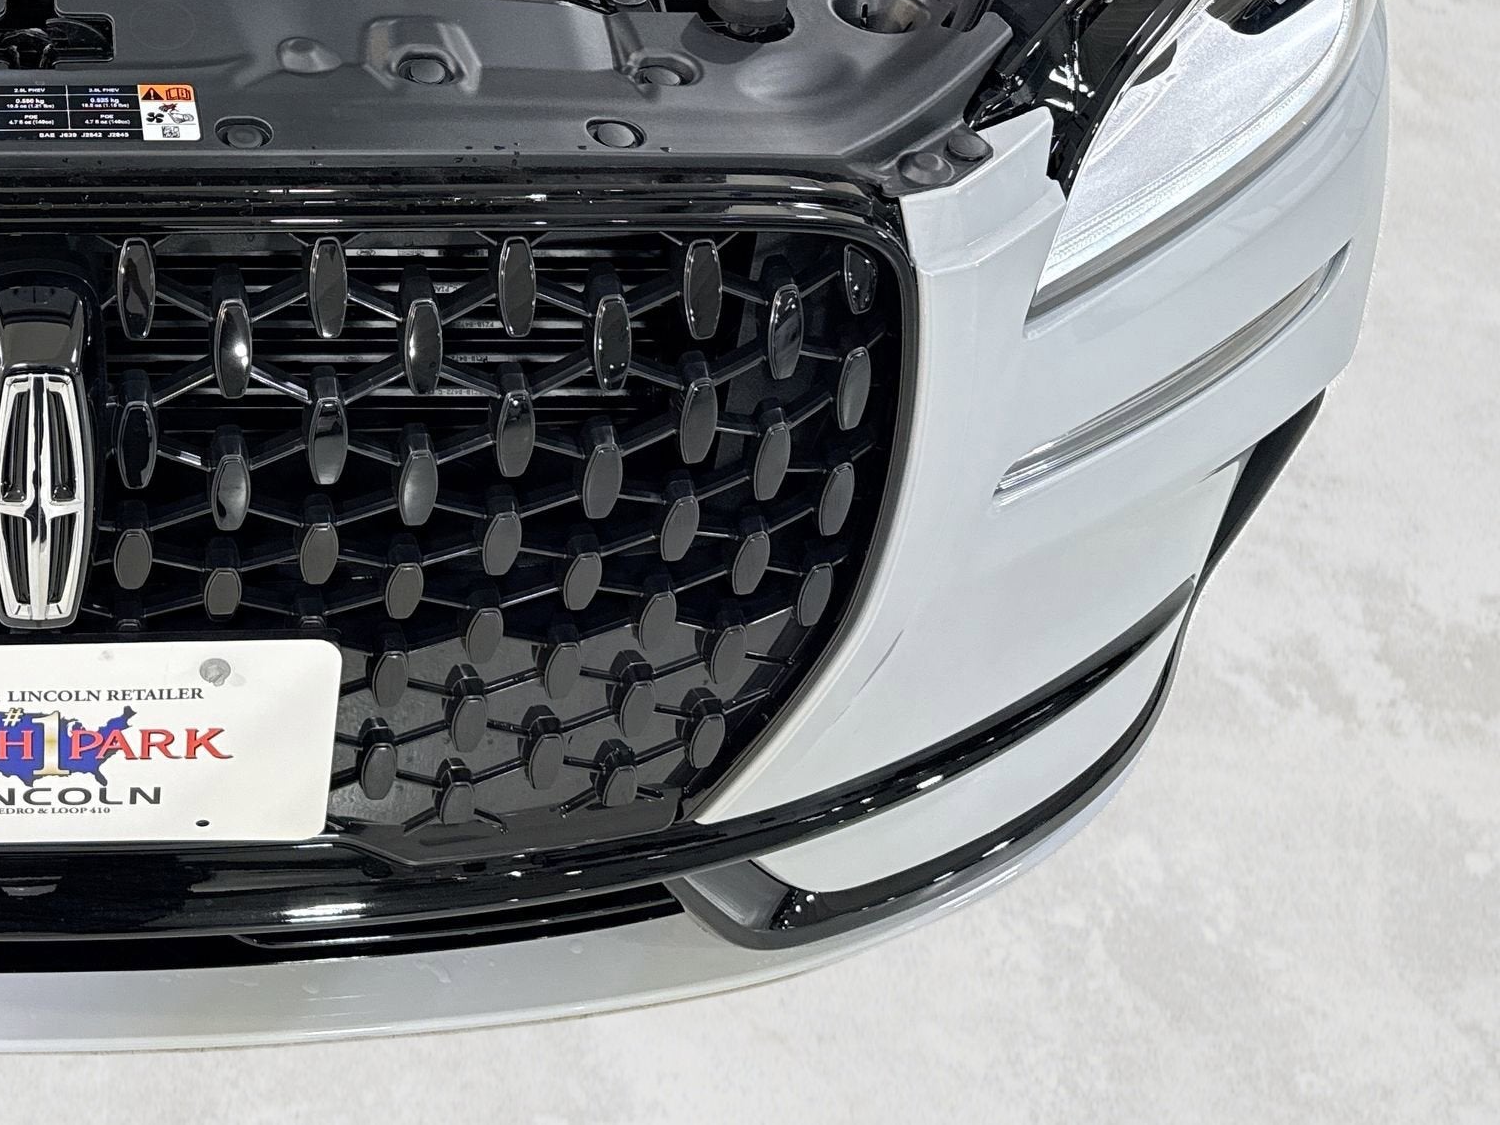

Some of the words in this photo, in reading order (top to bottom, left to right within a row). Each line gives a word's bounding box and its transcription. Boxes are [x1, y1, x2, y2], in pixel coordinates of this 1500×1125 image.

[8, 689, 101, 702] LINCOLN
[107, 687, 204, 701] RETAILER
[68, 727, 234, 761] PARK
[37, 807, 48, 815] &
[51, 807, 88, 815] LOOP
[89, 807, 111, 815] 410
